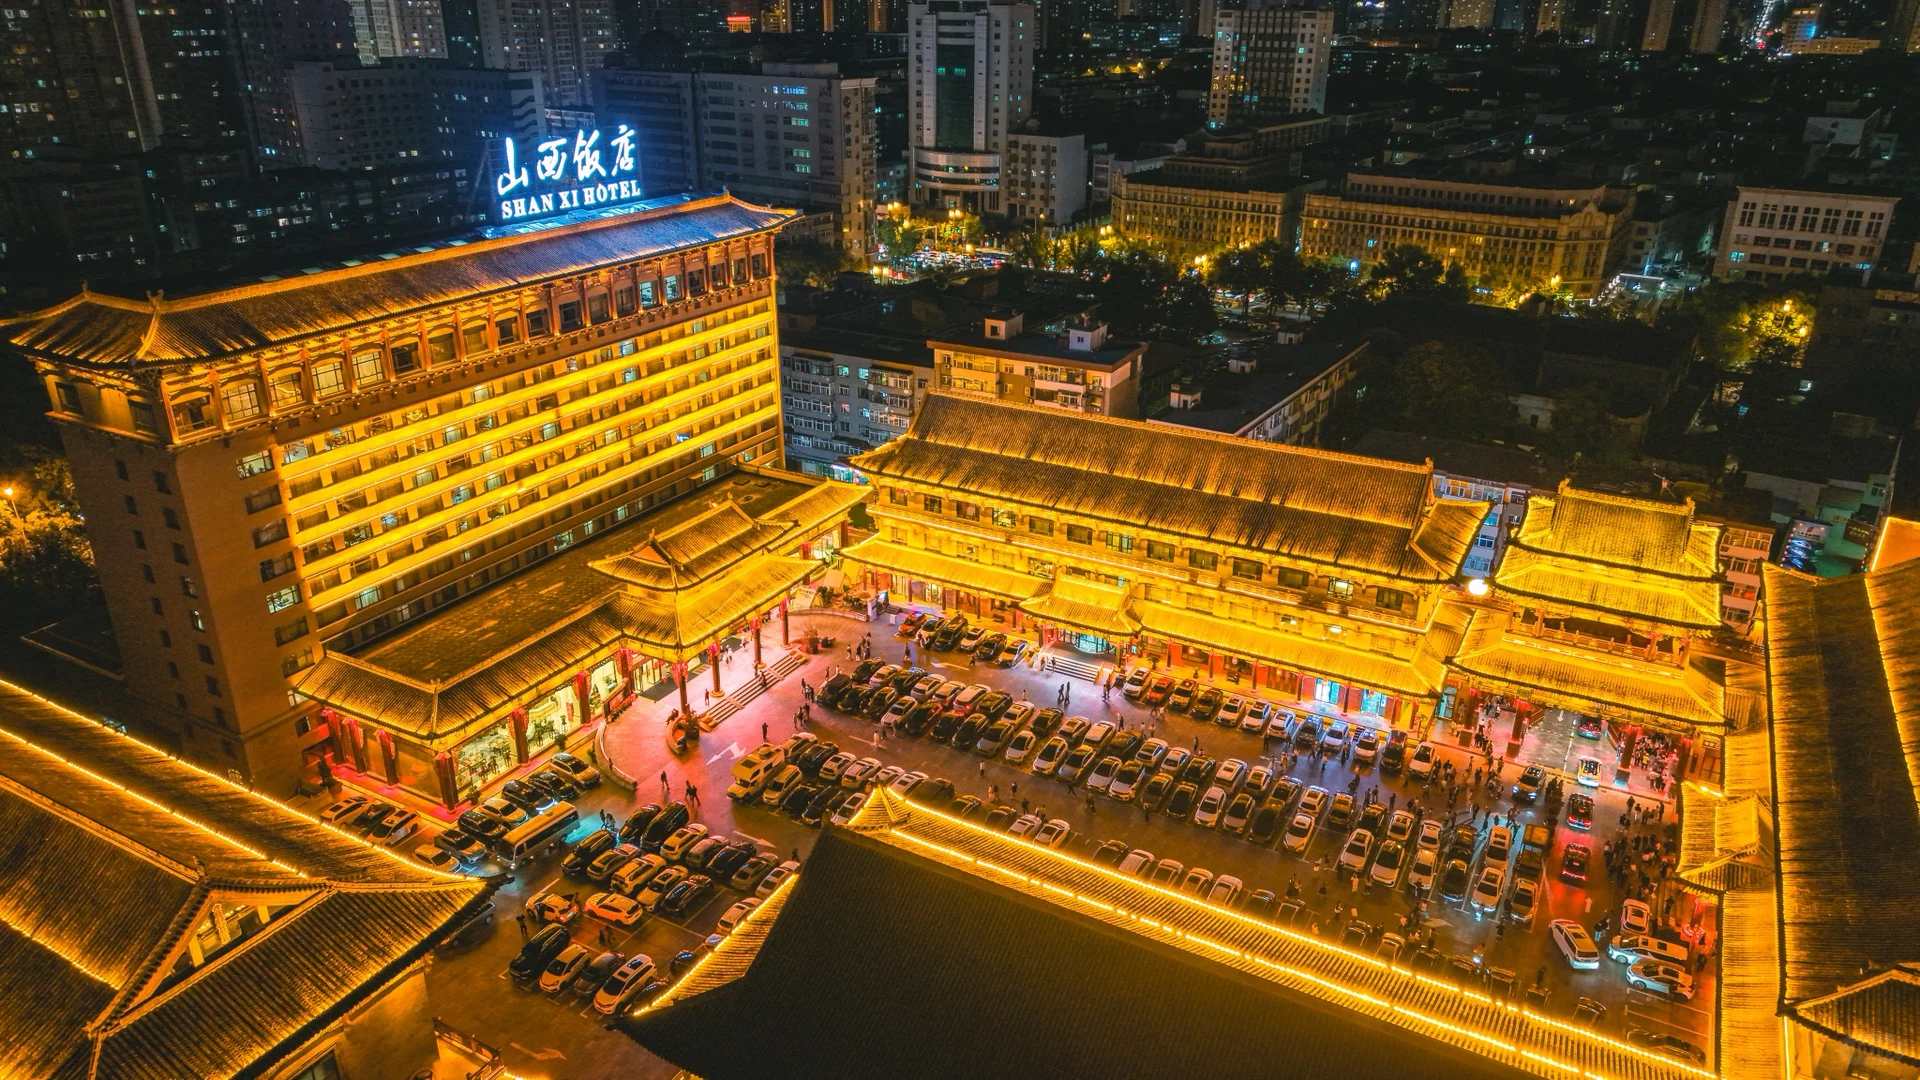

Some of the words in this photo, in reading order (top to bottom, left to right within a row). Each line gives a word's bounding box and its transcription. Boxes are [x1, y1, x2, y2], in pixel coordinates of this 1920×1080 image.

[497, 124, 636, 196] 山西饭店
[502, 193, 554, 220] SHAN
[583, 179, 641, 205] HOTEL
